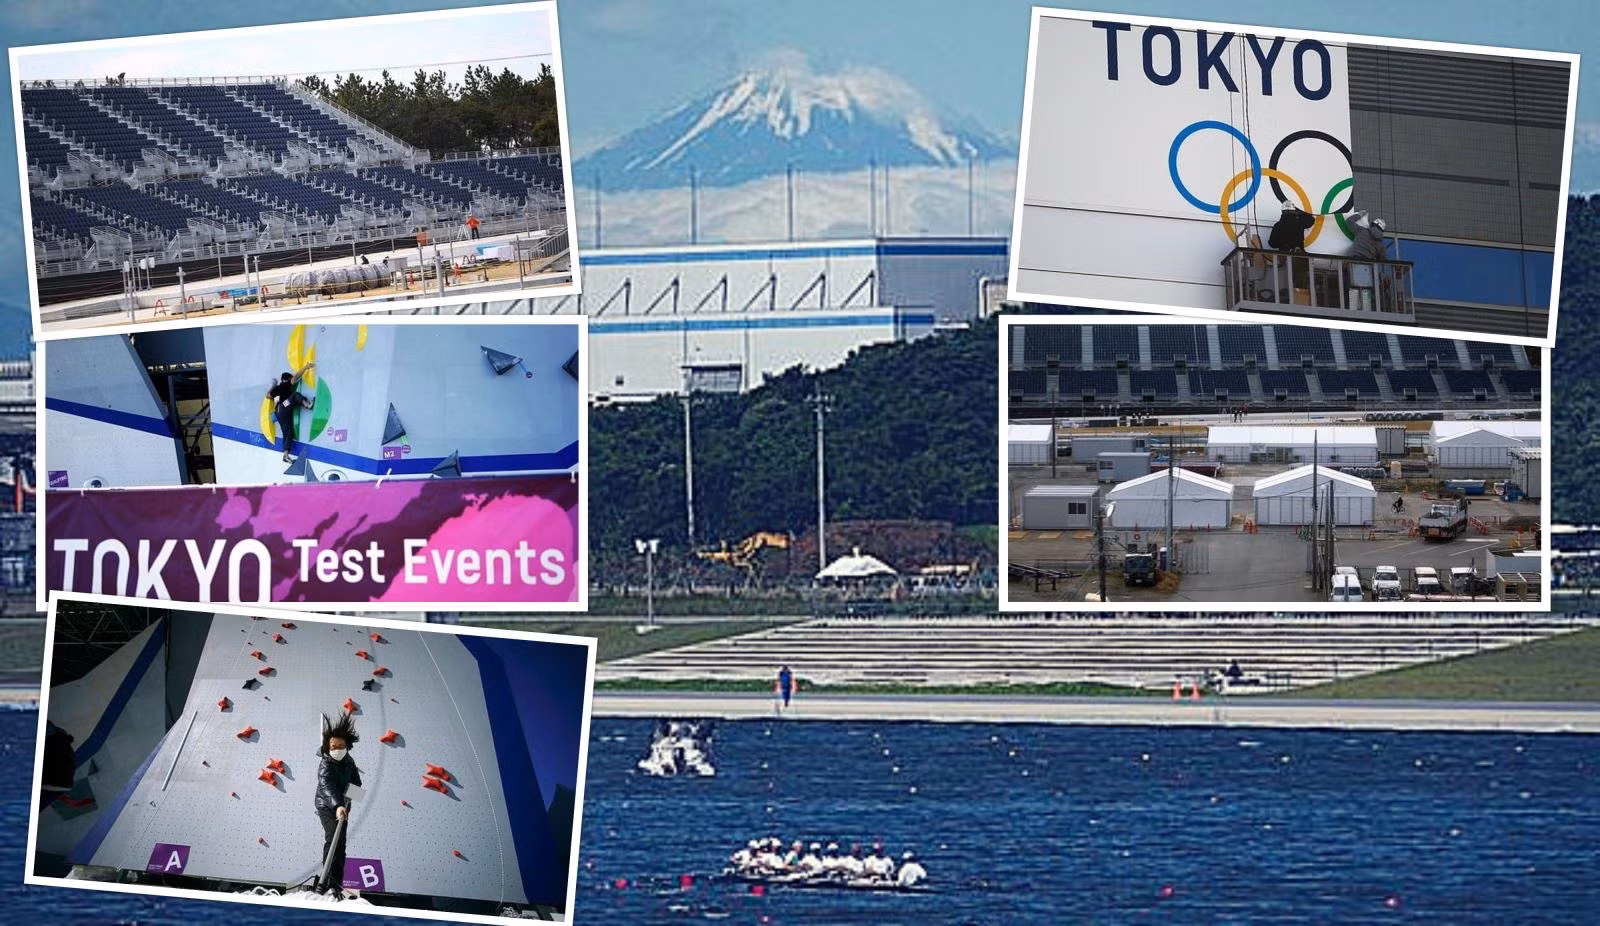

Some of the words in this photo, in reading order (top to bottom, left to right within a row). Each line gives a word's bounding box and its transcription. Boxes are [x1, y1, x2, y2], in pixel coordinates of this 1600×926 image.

[1092, 20, 1332, 100] TOKYO
[384, 450, 395, 458] M2
[54, 538, 272, 602] TOKYO
[292, 538, 385, 583] Test
[403, 538, 565, 584] Events
[164, 850, 182, 872] A
[359, 864, 379, 888] B
